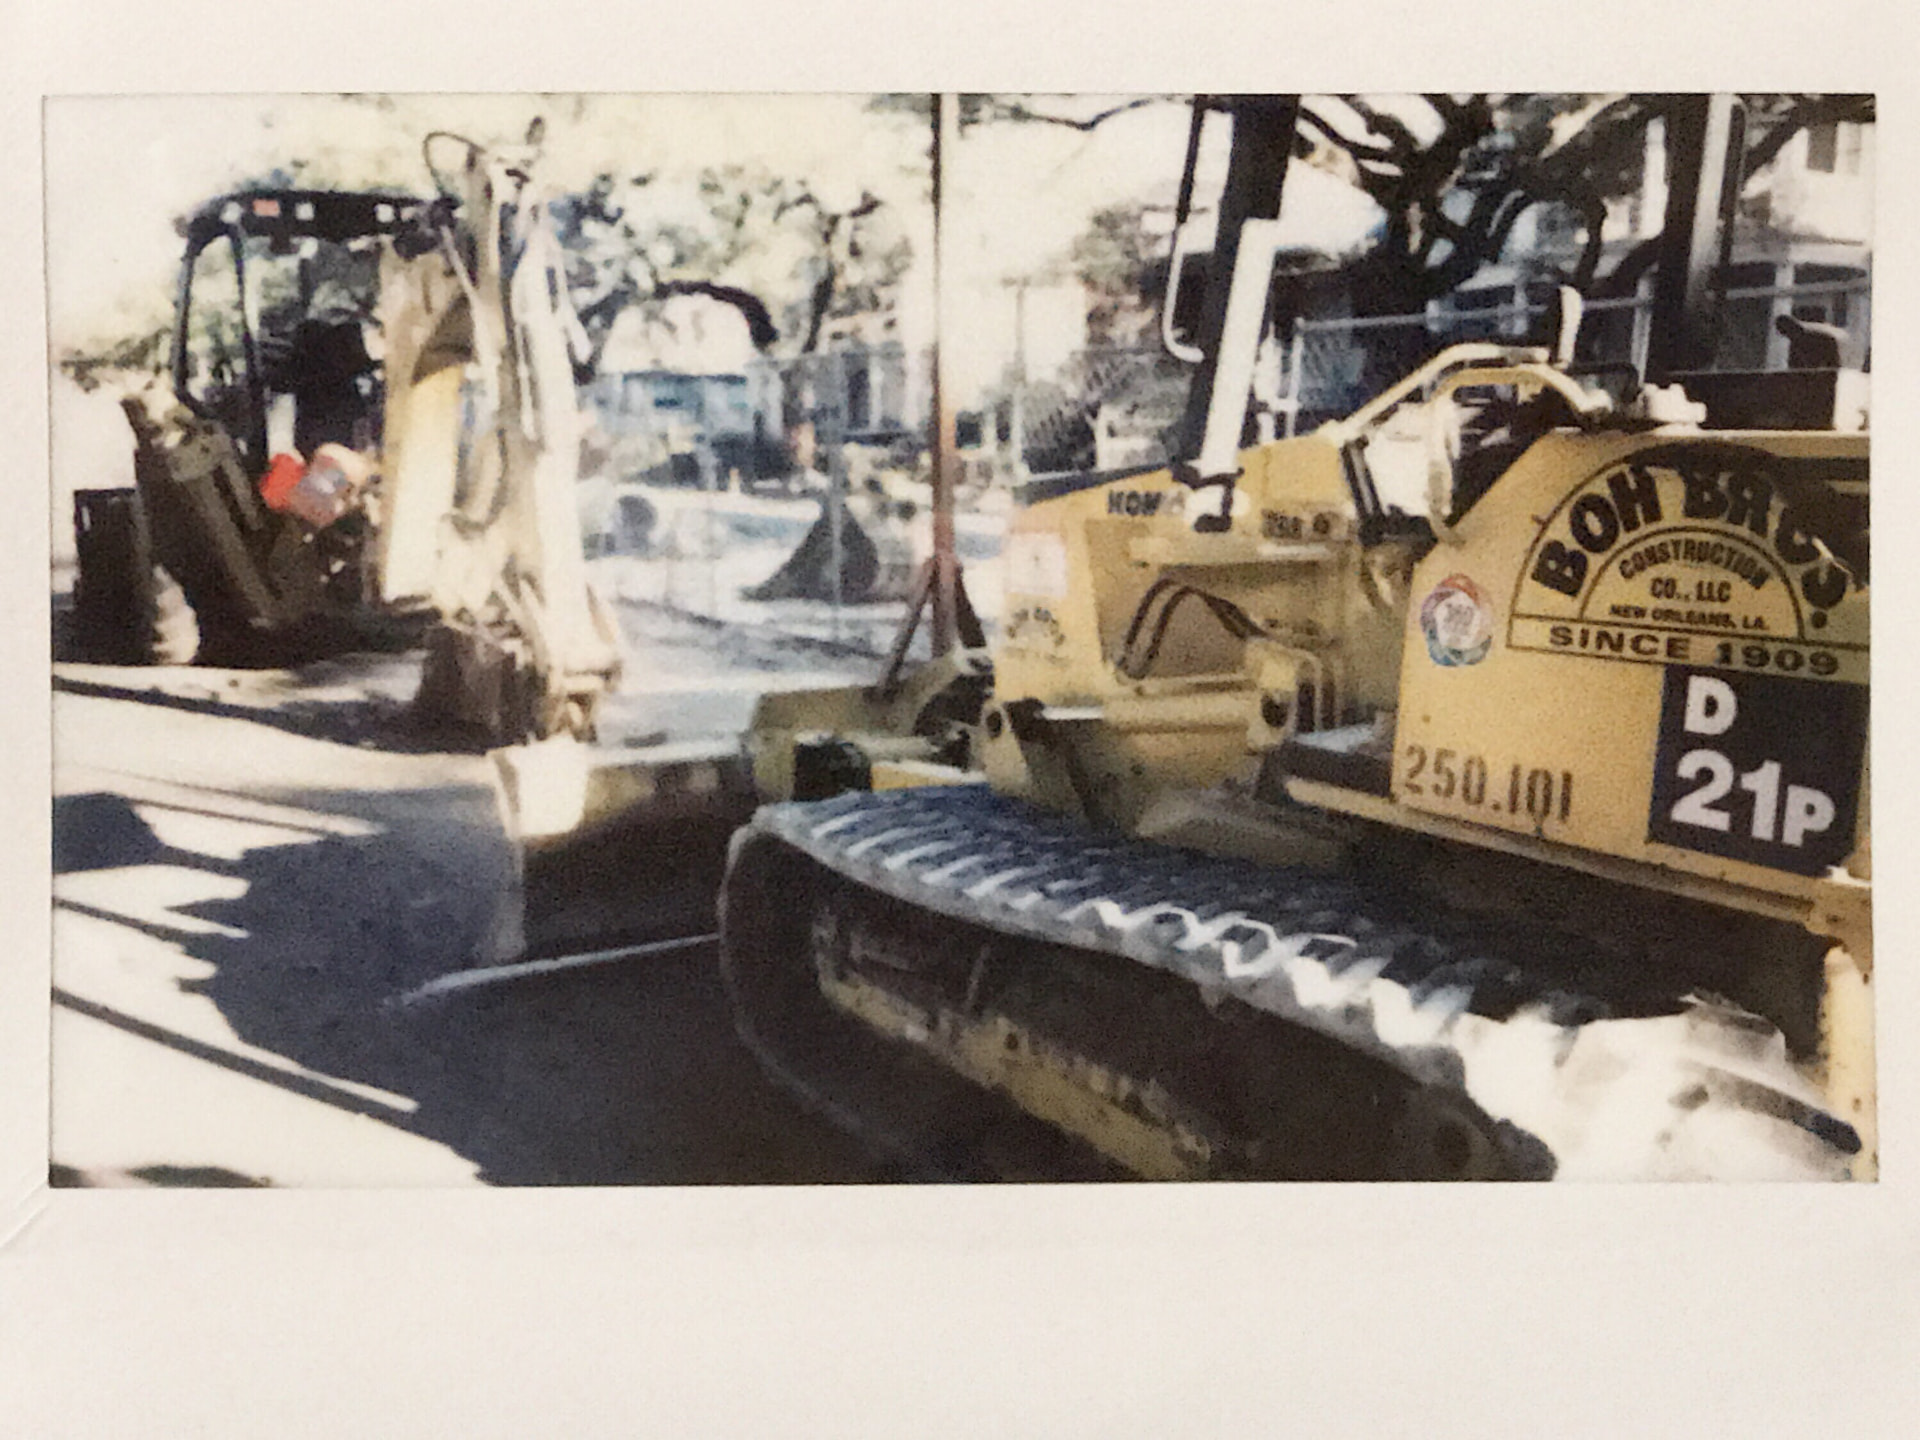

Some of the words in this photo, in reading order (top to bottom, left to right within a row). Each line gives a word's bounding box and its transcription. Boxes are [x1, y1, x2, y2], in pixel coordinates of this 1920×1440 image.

[1530, 464, 1664, 598] BOH
[1618, 537, 1771, 590] CONSTRUCTION
[1609, 604, 1648, 619] NEW
[1696, 580, 1732, 603] LLC
[1550, 625, 1691, 660] SINCE
[1715, 641, 1839, 676] 1909
[1684, 674, 1738, 736] D
[1671, 748, 1835, 848] 21P
